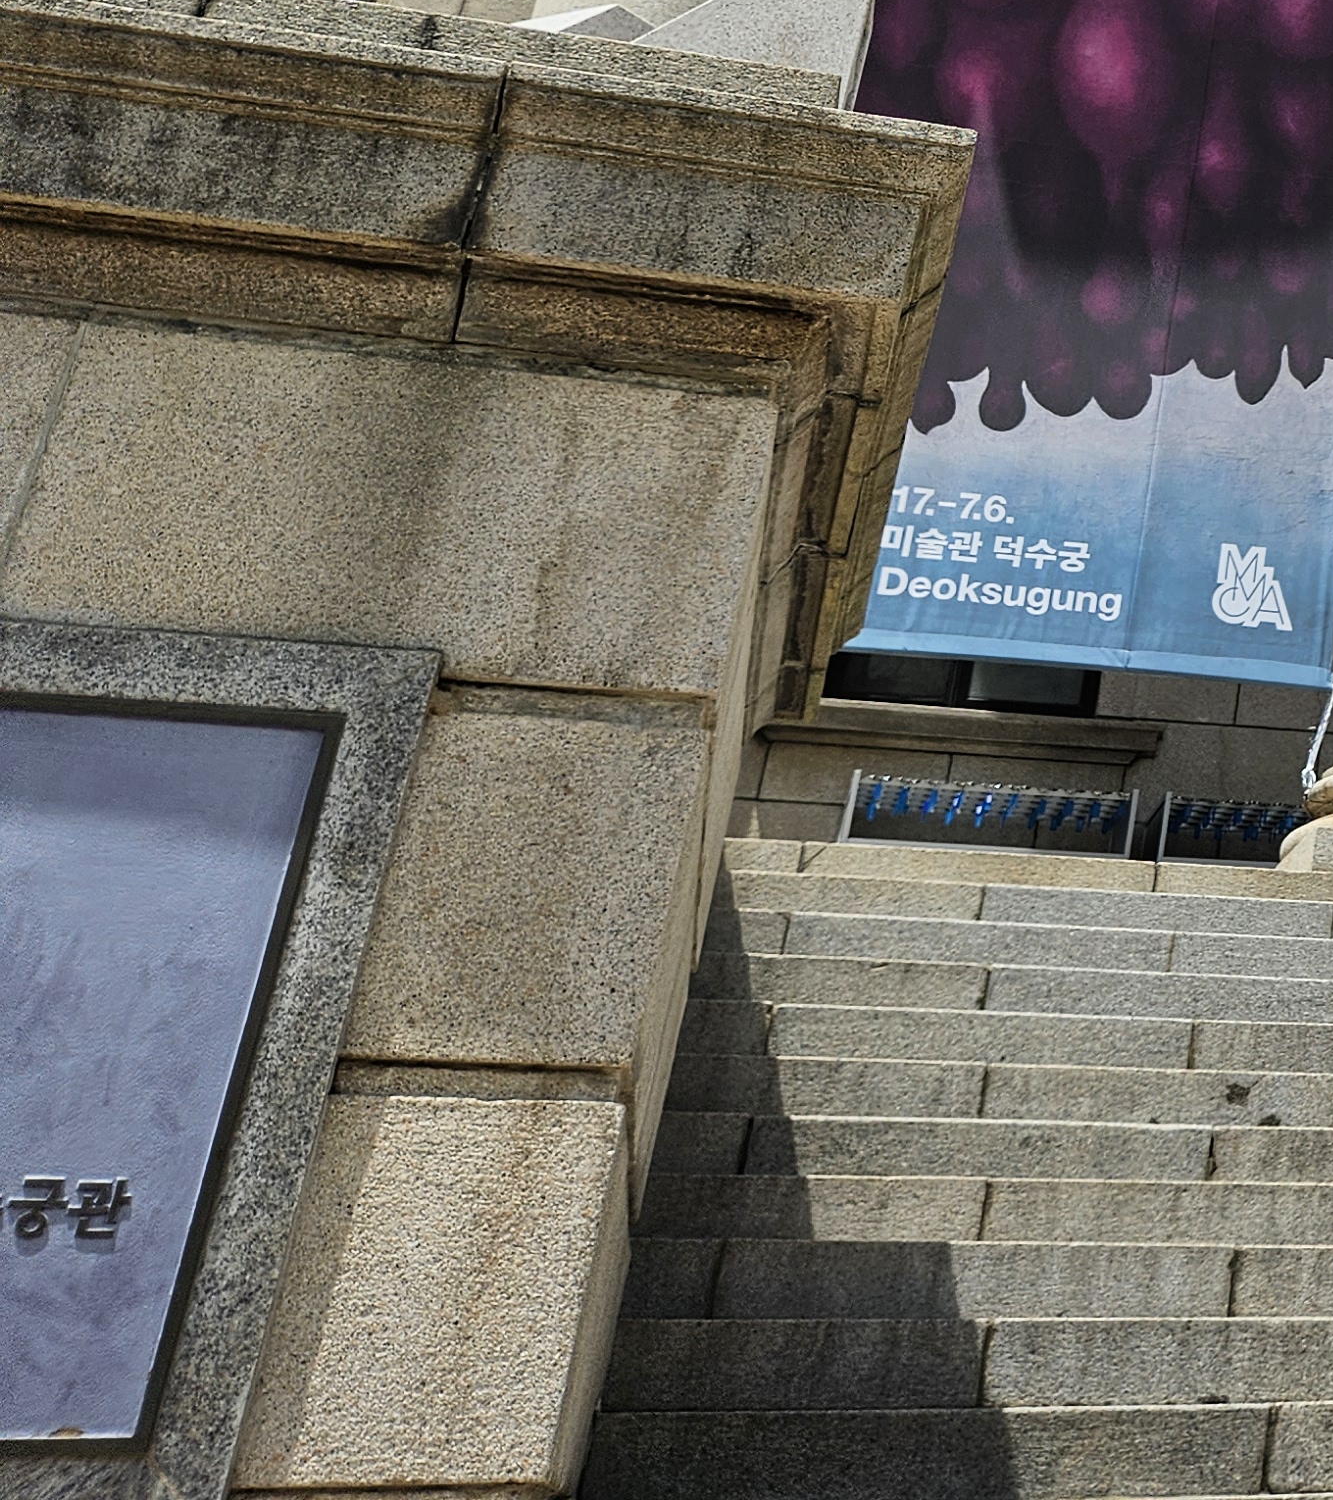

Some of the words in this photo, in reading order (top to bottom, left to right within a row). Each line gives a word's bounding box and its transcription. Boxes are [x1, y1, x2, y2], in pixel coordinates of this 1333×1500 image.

[880, 524, 982, 563] 미술관
[993, 536, 1090, 572] 덕수궁
[877, 566, 1122, 621] Deoksugung
[0, 1174, 133, 1240] 궁관
